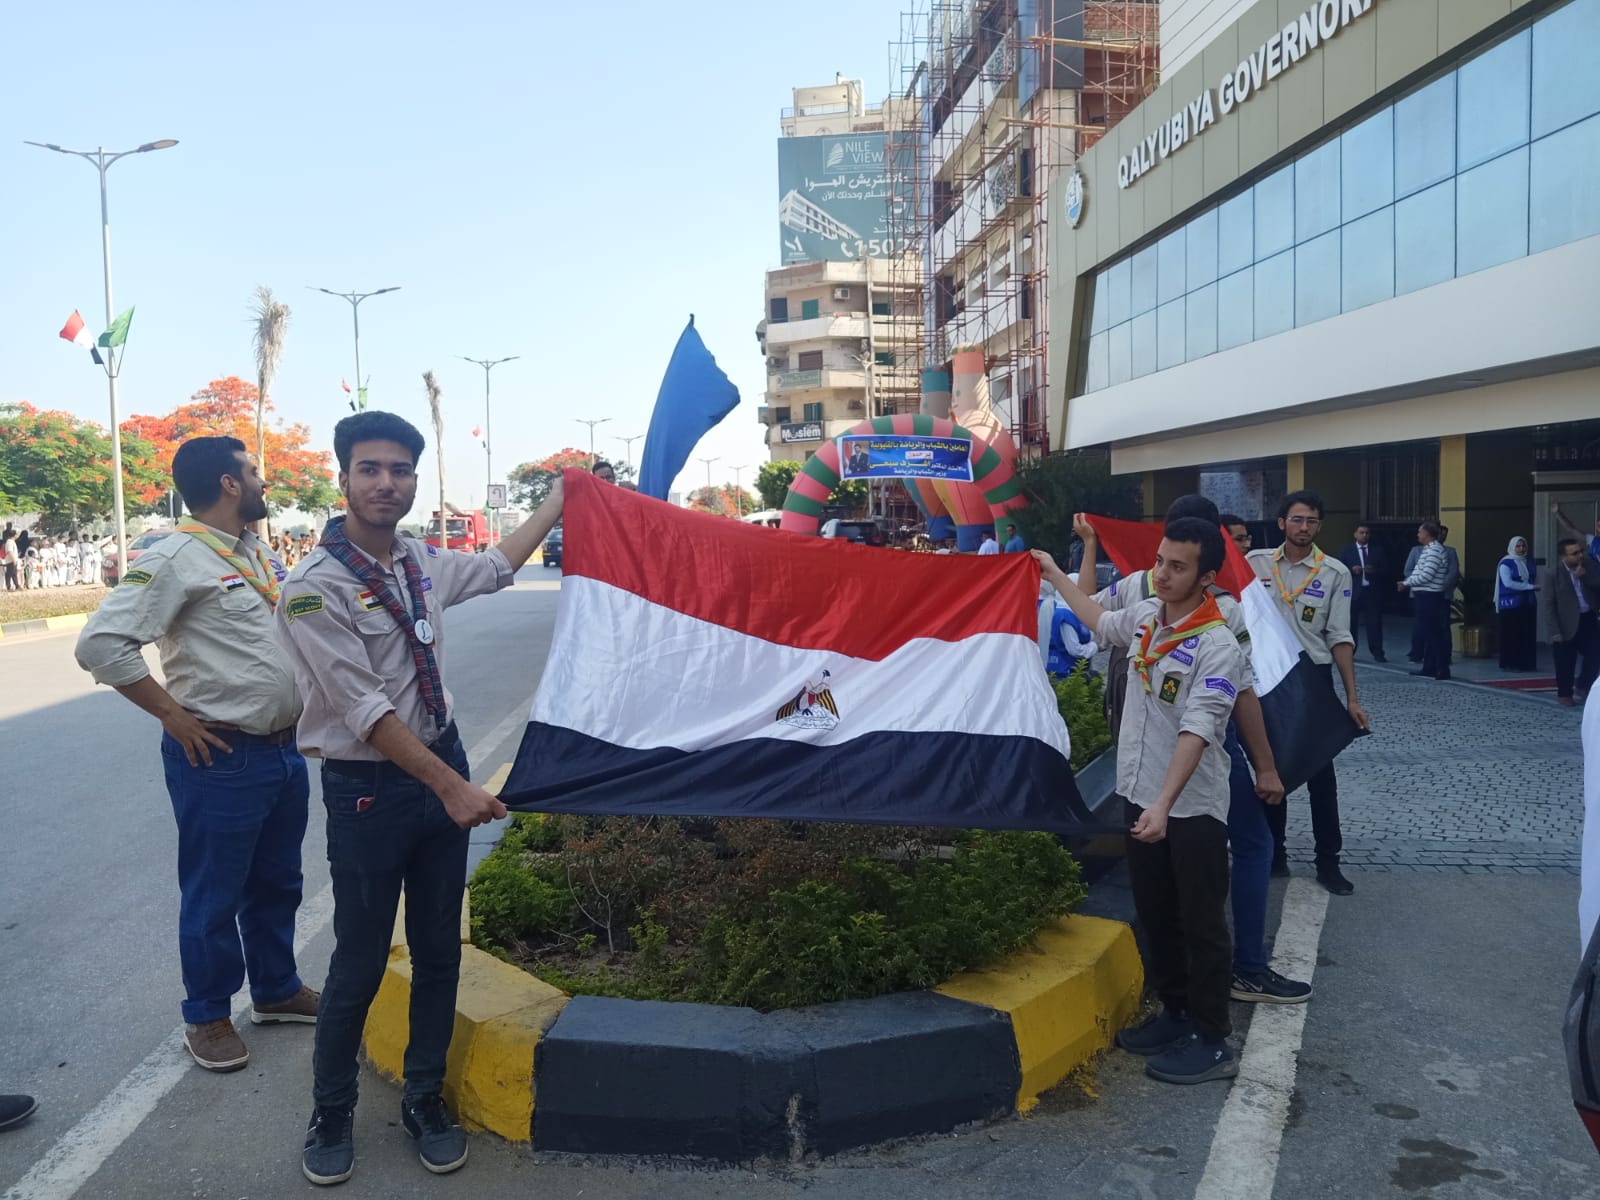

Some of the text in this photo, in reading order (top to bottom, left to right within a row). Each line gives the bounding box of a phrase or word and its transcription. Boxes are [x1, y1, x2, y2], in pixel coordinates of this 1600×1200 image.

[1118, 0, 1372, 189] QALYUBIYA GOVERNOR
[845, 140, 871, 153] NILE
[852, 151, 885, 164] VIEW
